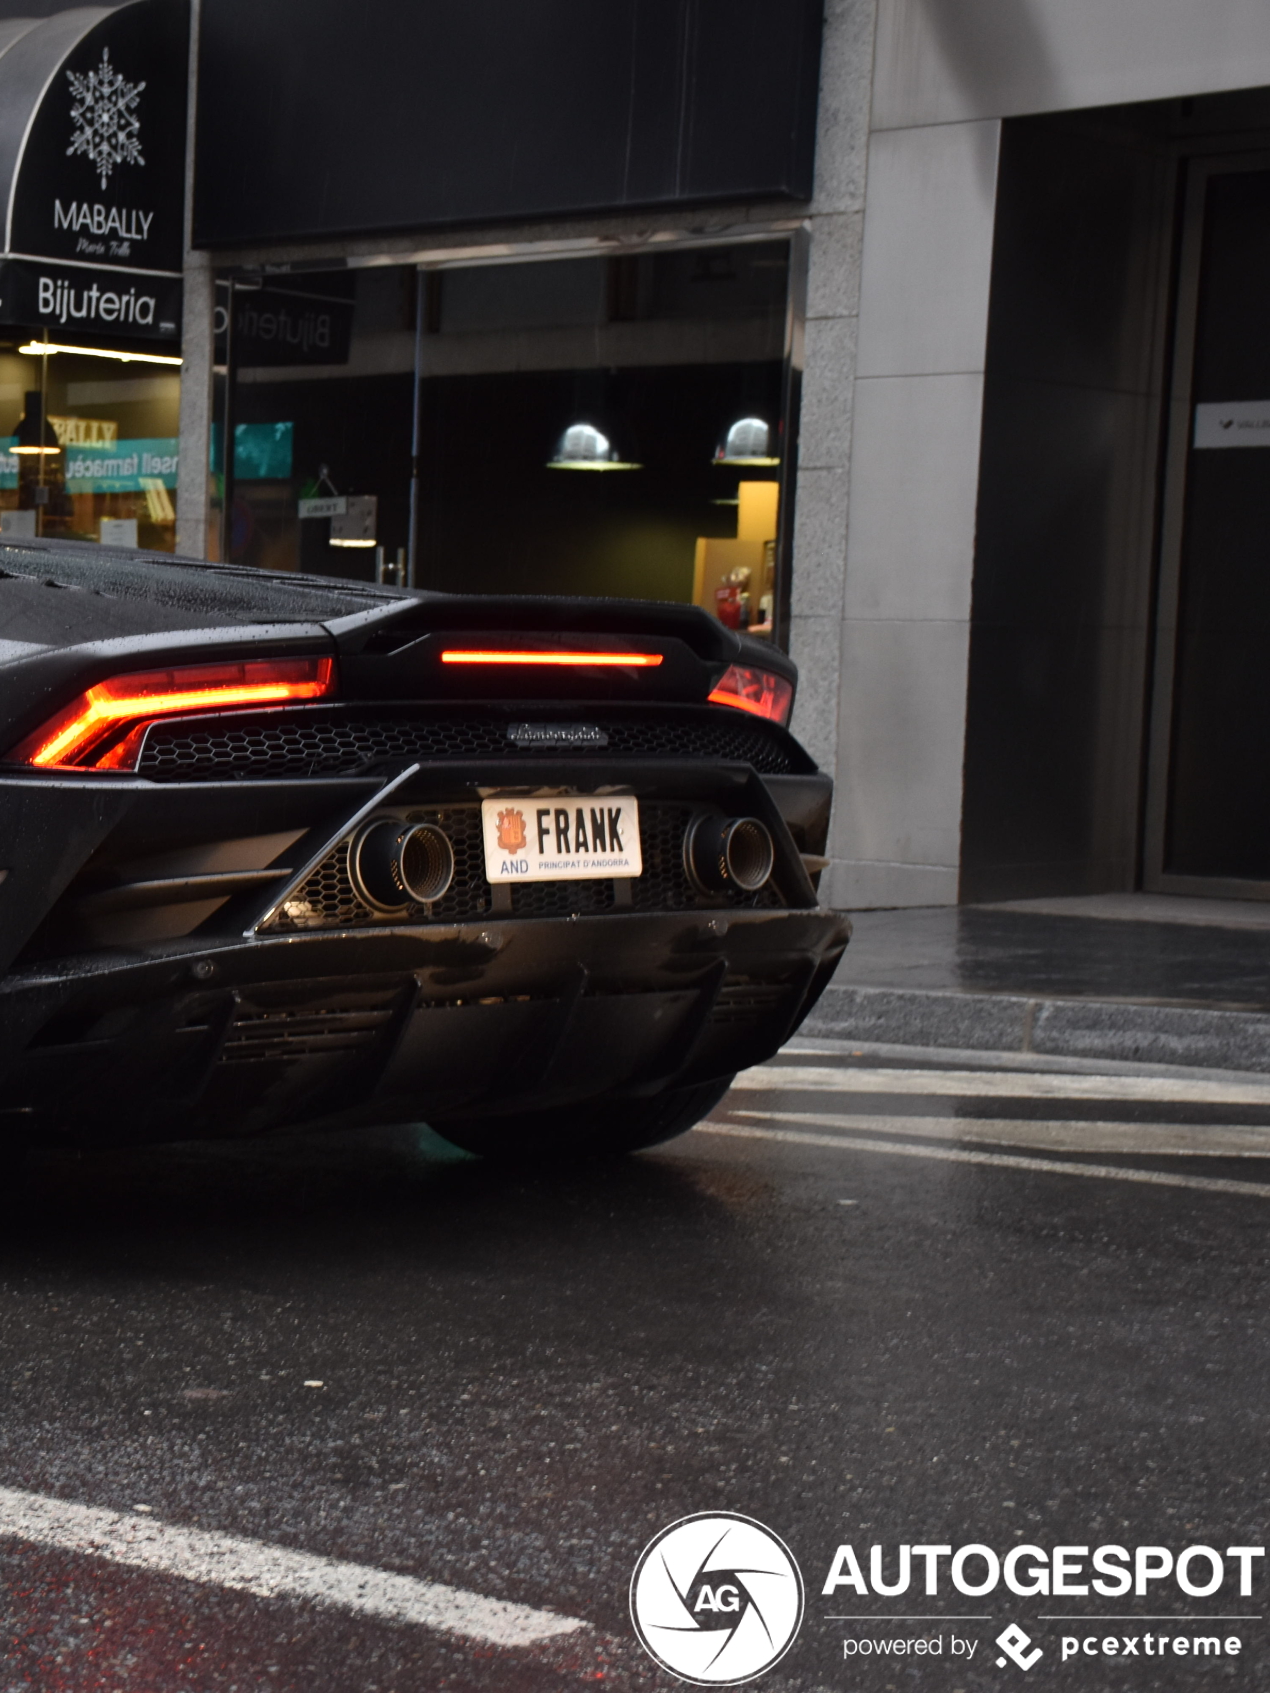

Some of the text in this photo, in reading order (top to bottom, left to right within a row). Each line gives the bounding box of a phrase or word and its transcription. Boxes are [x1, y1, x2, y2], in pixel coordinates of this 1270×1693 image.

[53, 198, 154, 240] MABALLY
[38, 276, 156, 324] Bijuteria
[536, 807, 623, 854] FRANK
[500, 859, 529, 874] AND
[538, 858, 630, 870] PRINCIPAT D'ANDORRA
